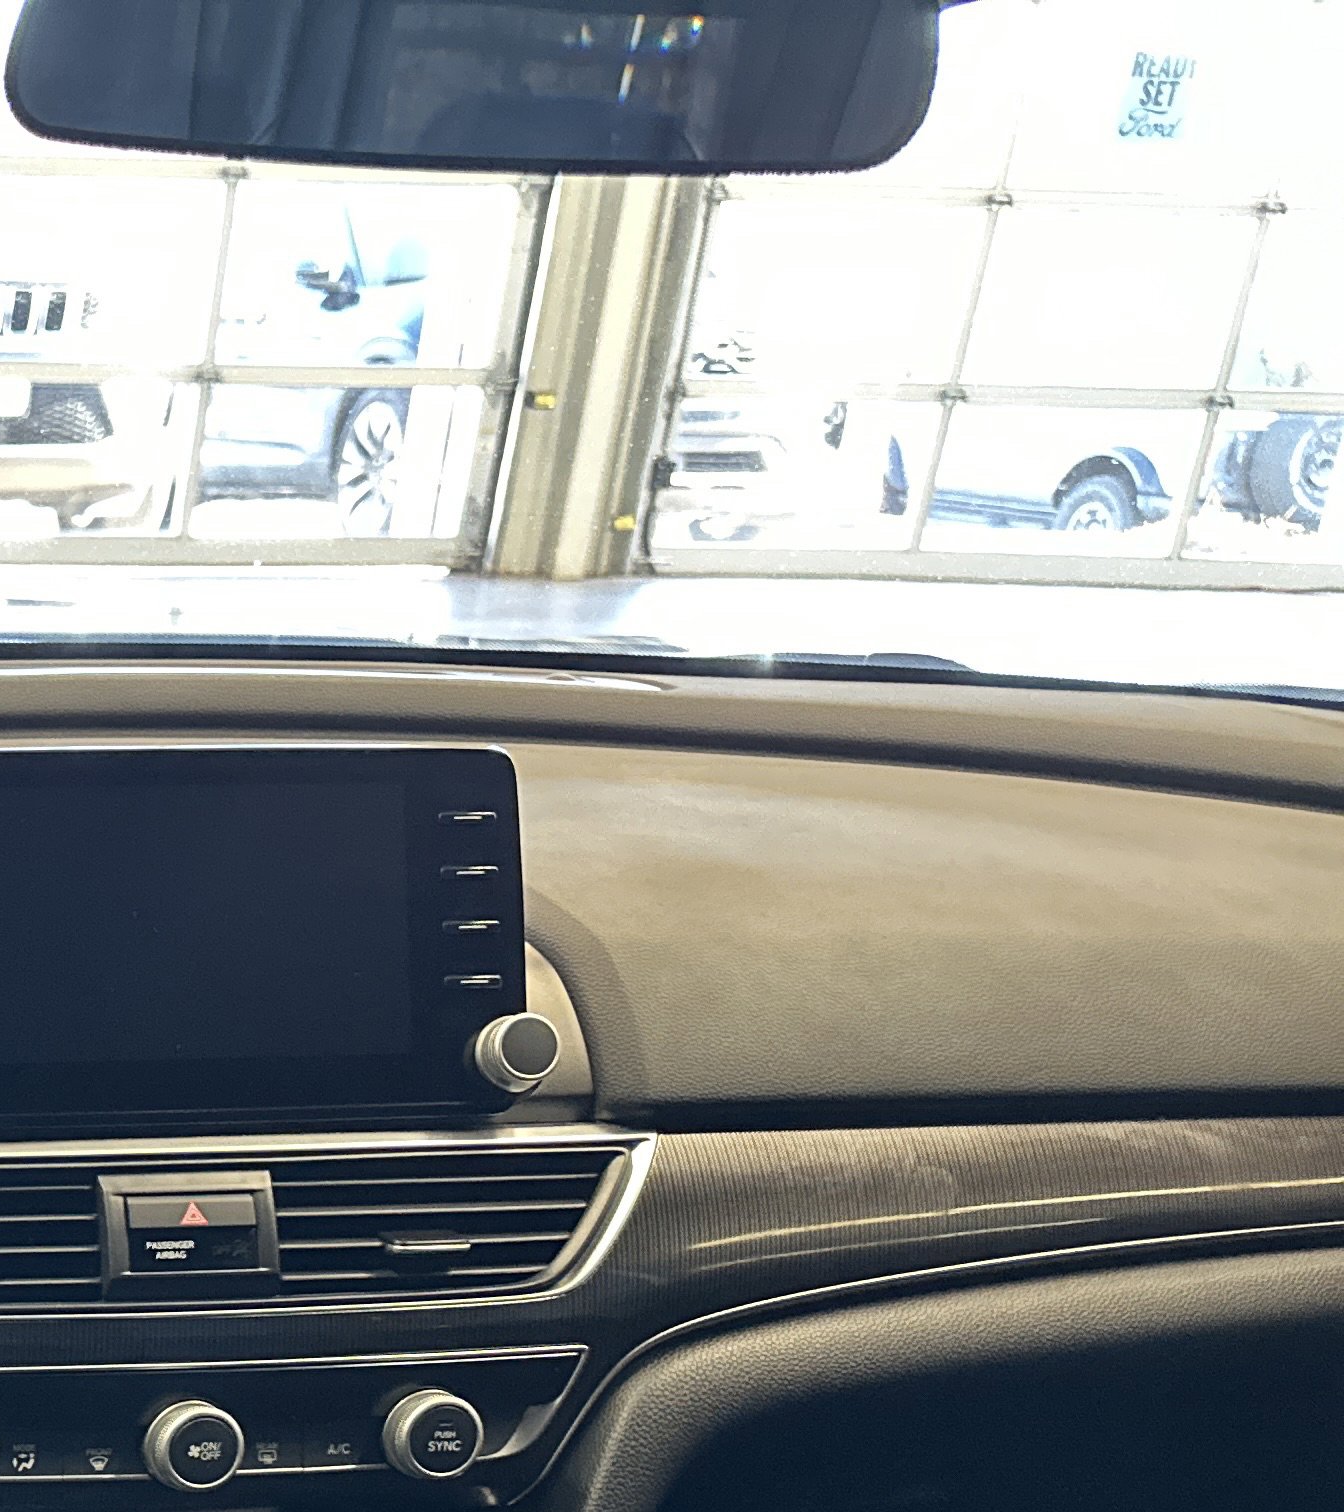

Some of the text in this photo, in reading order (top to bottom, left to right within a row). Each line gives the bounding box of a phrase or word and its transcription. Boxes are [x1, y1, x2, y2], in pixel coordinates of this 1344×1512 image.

[1139, 79, 1180, 107] SET
[1119, 107, 1182, 138] Ford
[155, 1250, 187, 1260] AIRBAG
[433, 1430, 457, 1440] PUSH
[327, 1443, 351, 1455] A/C
[427, 1440, 463, 1453] SYNC
[200, 1450, 221, 1461] OFF
